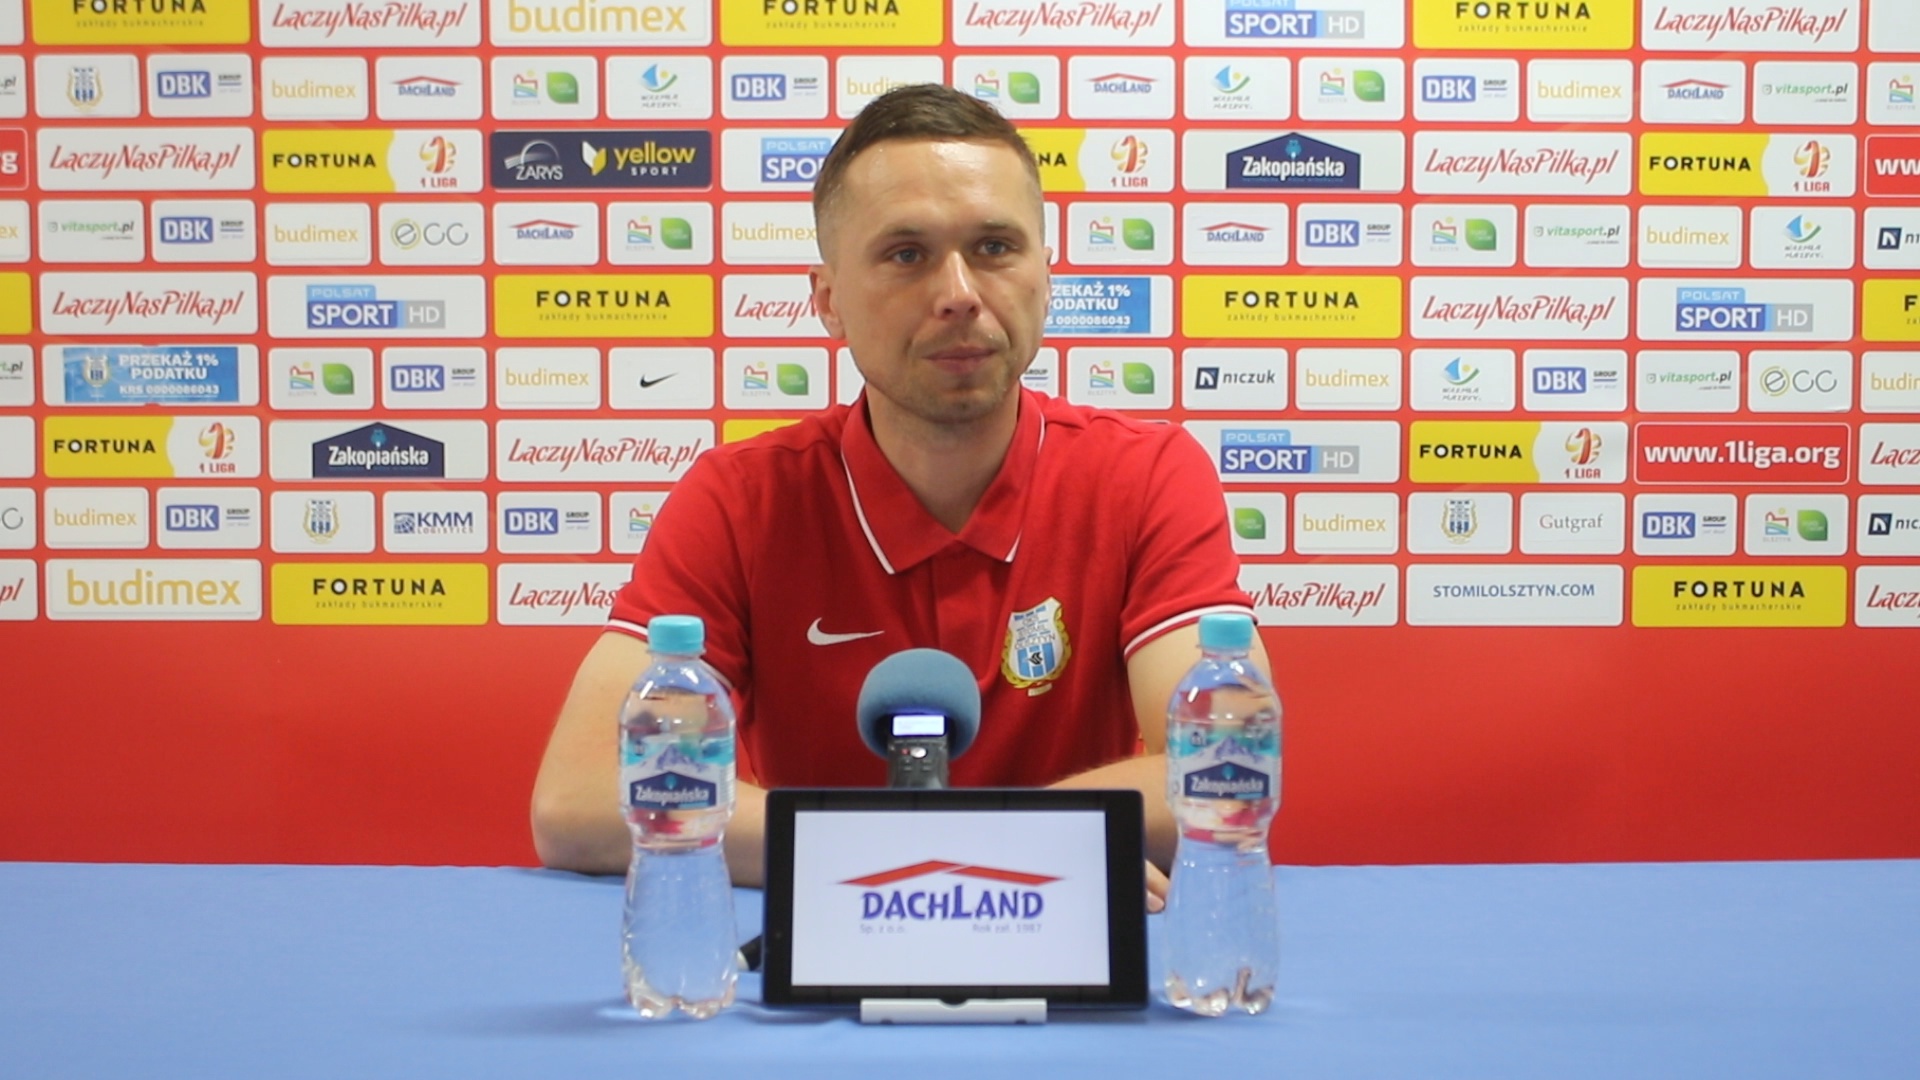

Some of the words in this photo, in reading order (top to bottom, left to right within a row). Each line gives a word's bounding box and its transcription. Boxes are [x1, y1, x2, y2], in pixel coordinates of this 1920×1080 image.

[74, 0, 206, 13] FORTUNA
[764, 0, 898, 15] FORTUNA
[1457, 2, 1590, 19] FORTUNA
[508, 0, 687, 32] budimex
[1230, 14, 1312, 35] SPORT
[1329, 16, 1359, 33] HD
[162, 77, 207, 96] DBK
[272, 80, 355, 98] budimex
[736, 78, 782, 98] DBK
[1426, 79, 1471, 99] DBK
[1538, 80, 1621, 98] budimex
[1775, 83, 1848, 96] vitasport.pl
[766, 141, 827, 151] POLSAT
[273, 154, 375, 168] FORTUNA
[613, 141, 696, 169] yellow
[1650, 156, 1750, 171] FORTUNA
[516, 166, 563, 180] ZARYS
[631, 167, 677, 175] SPORT
[1243, 156, 1344, 180] Zakopiańska
[431, 177, 457, 187] LIGA
[1122, 177, 1148, 187] LIGA
[1804, 182, 1830, 191] LIGA
[61, 221, 134, 235] vitasport.pl
[164, 220, 209, 240] DBK
[274, 224, 357, 242] budimex
[391, 219, 468, 249] ecc
[732, 223, 817, 241] budimex
[1309, 224, 1354, 244] DBK
[1548, 225, 1620, 239] vitasport.pl
[1647, 226, 1728, 245] budimex
[309, 288, 372, 298] POLSAT
[1051, 281, 1104, 297] ZEKAŻ
[1108, 285, 1130, 297] 1%
[1682, 290, 1740, 300] POLSAT
[537, 291, 670, 307] FORTUNA
[1225, 291, 1358, 308] FORTUNA
[312, 304, 393, 326] SPORT
[409, 306, 440, 323] HD
[1681, 307, 1761, 328] SPORT
[1778, 310, 1807, 326] HD
[118, 352, 192, 367] PRZEKAŻ
[196, 354, 218, 366] 1%
[131, 368, 209, 380] PODATKU
[395, 369, 440, 389] DBK
[506, 368, 588, 386] budimex
[1223, 370, 1274, 383] niczuk
[1306, 369, 1389, 387] budimex
[1537, 370, 1582, 390] DBK
[1660, 371, 1732, 385] vitasport.pl
[1761, 367, 1837, 396] ecc
[120, 385, 144, 397] KRS
[54, 439, 155, 453] FORTUNA
[1226, 433, 1285, 443] POLSAT
[329, 445, 428, 469] Zakopiańska
[1224, 449, 1307, 470] SPORT
[1323, 452, 1354, 468] HD
[1420, 444, 1521, 458] FORTUNA
[1645, 441, 1840, 468] www.1liga.org
[210, 463, 235, 473] LIGA
[1575, 469, 1600, 478] LIGA
[54, 508, 136, 526] budimex
[169, 506, 215, 527] DBK
[418, 512, 472, 527] KMM
[509, 509, 554, 531] DBK
[1303, 514, 1385, 531] budimex
[1540, 514, 1602, 533] Gutgraf
[1647, 515, 1691, 535] DBK
[67, 569, 240, 606] budimex
[314, 579, 445, 595] FORTUNA
[1434, 584, 1594, 597] STOMILOLSZTYN.COM
[1674, 581, 1804, 597] FORTUNA
[509, 583, 618, 614] LaczyNas
[1249, 582, 1386, 617] yNasPilka.pl
[862, 885, 1043, 920] DACHLAND
